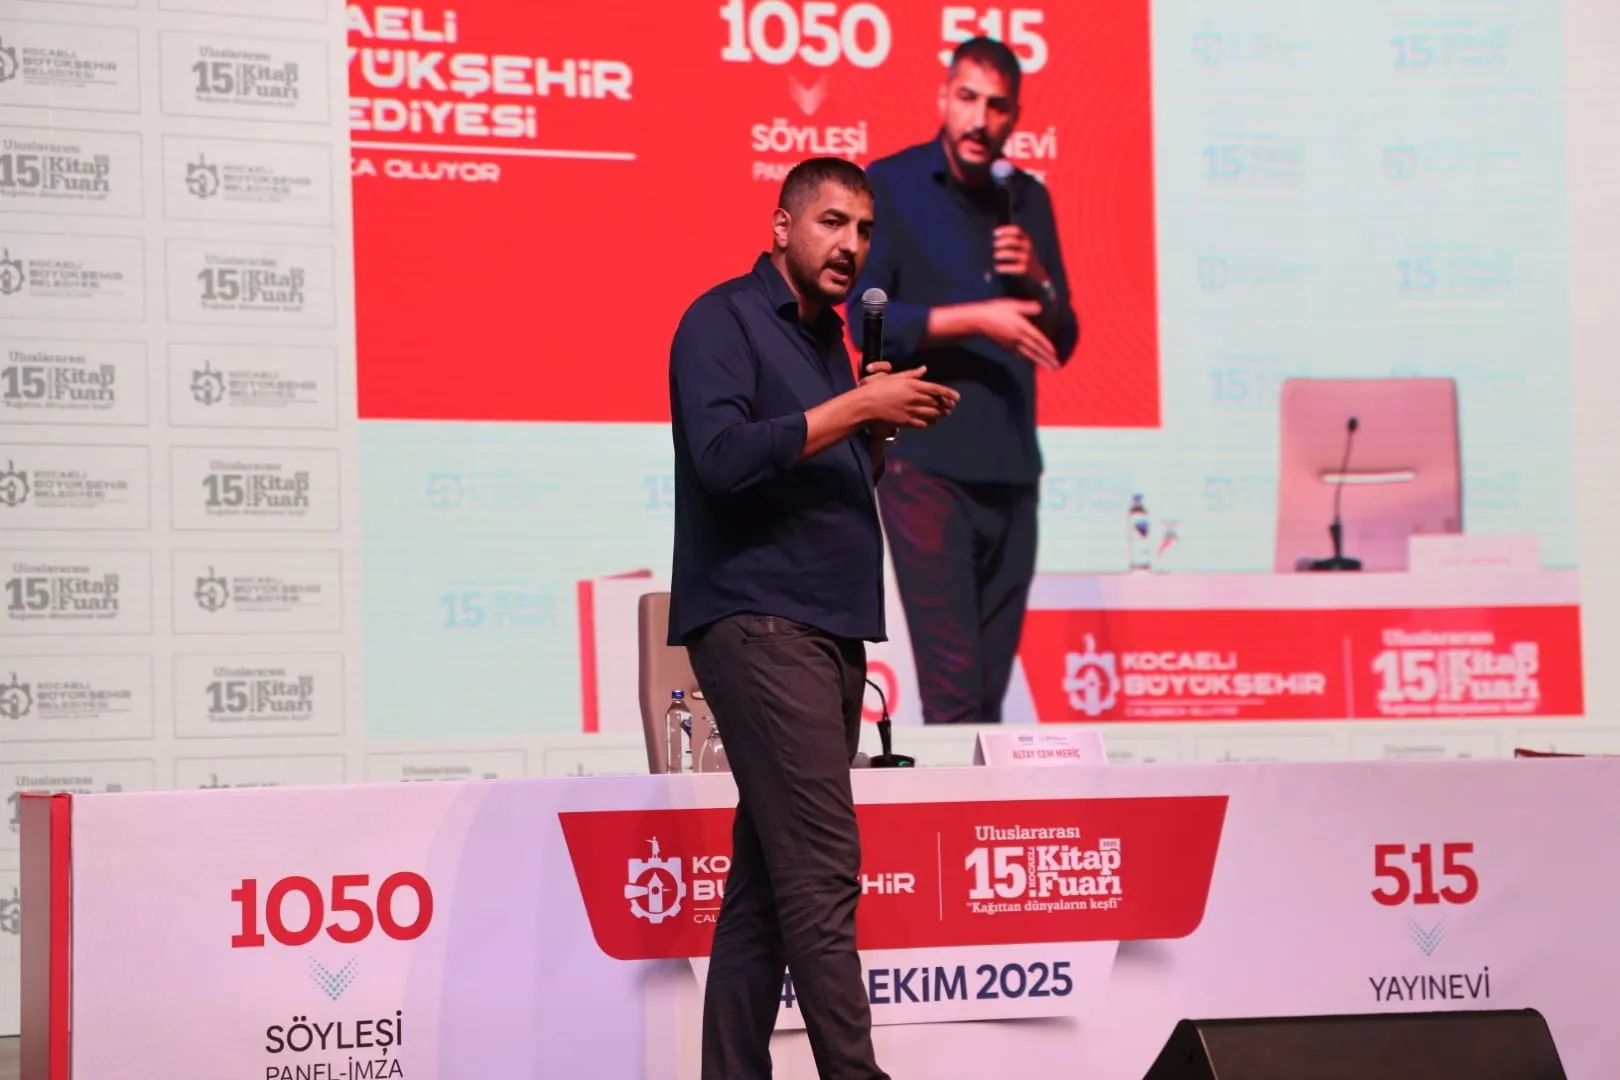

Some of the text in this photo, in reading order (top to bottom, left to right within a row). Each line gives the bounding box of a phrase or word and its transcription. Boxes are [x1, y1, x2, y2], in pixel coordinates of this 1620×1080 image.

[720, 0, 891, 68] 1050
[384, 159, 501, 182] OLUYOR
[975, 826, 1081, 841] Uluslararası
[1036, 845, 1122, 875] Kitap
[1371, 842, 1479, 906] 515
[1037, 872, 1122, 897] Fuarı
[231, 871, 434, 948] 1050
[976, 962, 1073, 999] 2025
[1368, 966, 1490, 1001] YAYINEVİ
[265, 1010, 402, 1056] SÖYLEŞİ
